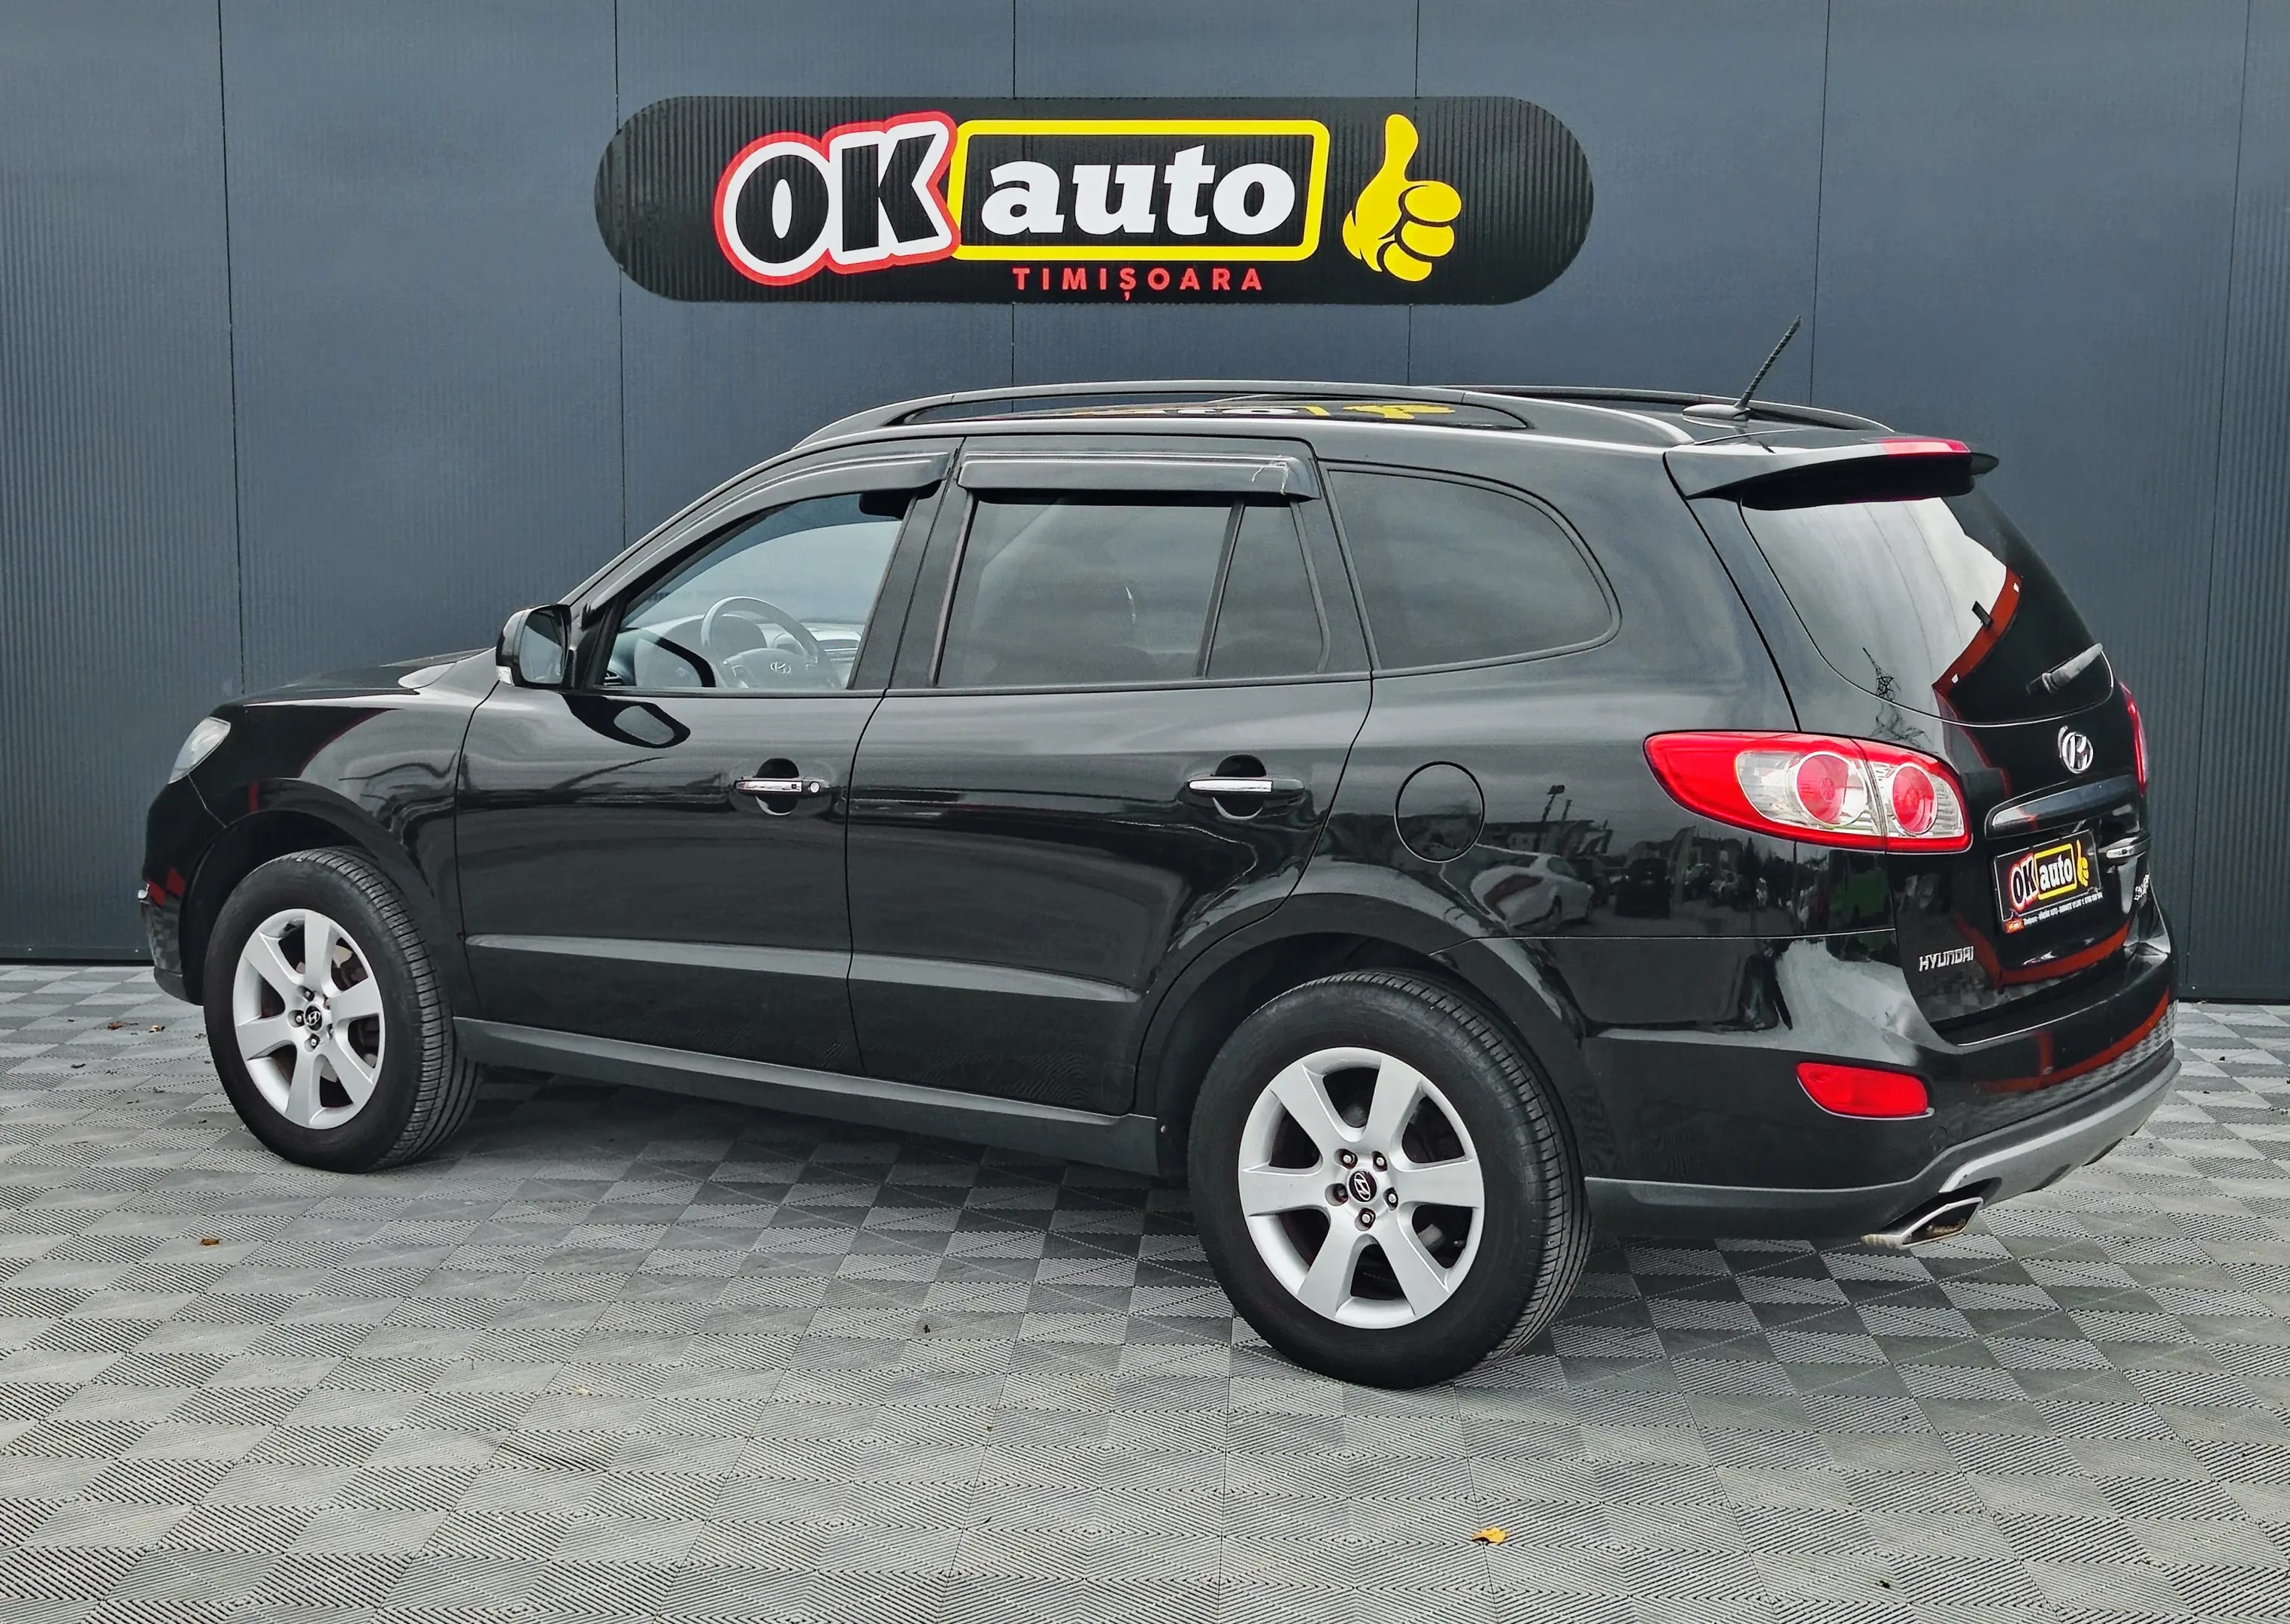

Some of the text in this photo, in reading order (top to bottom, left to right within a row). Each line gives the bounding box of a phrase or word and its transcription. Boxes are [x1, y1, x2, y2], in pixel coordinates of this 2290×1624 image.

[722, 119, 1295, 278] OK auto
[1012, 267, 1265, 301] TIMIȘOARA
[2010, 854, 2073, 907] OK auto
[1919, 946, 1974, 971] HYUNDAI
